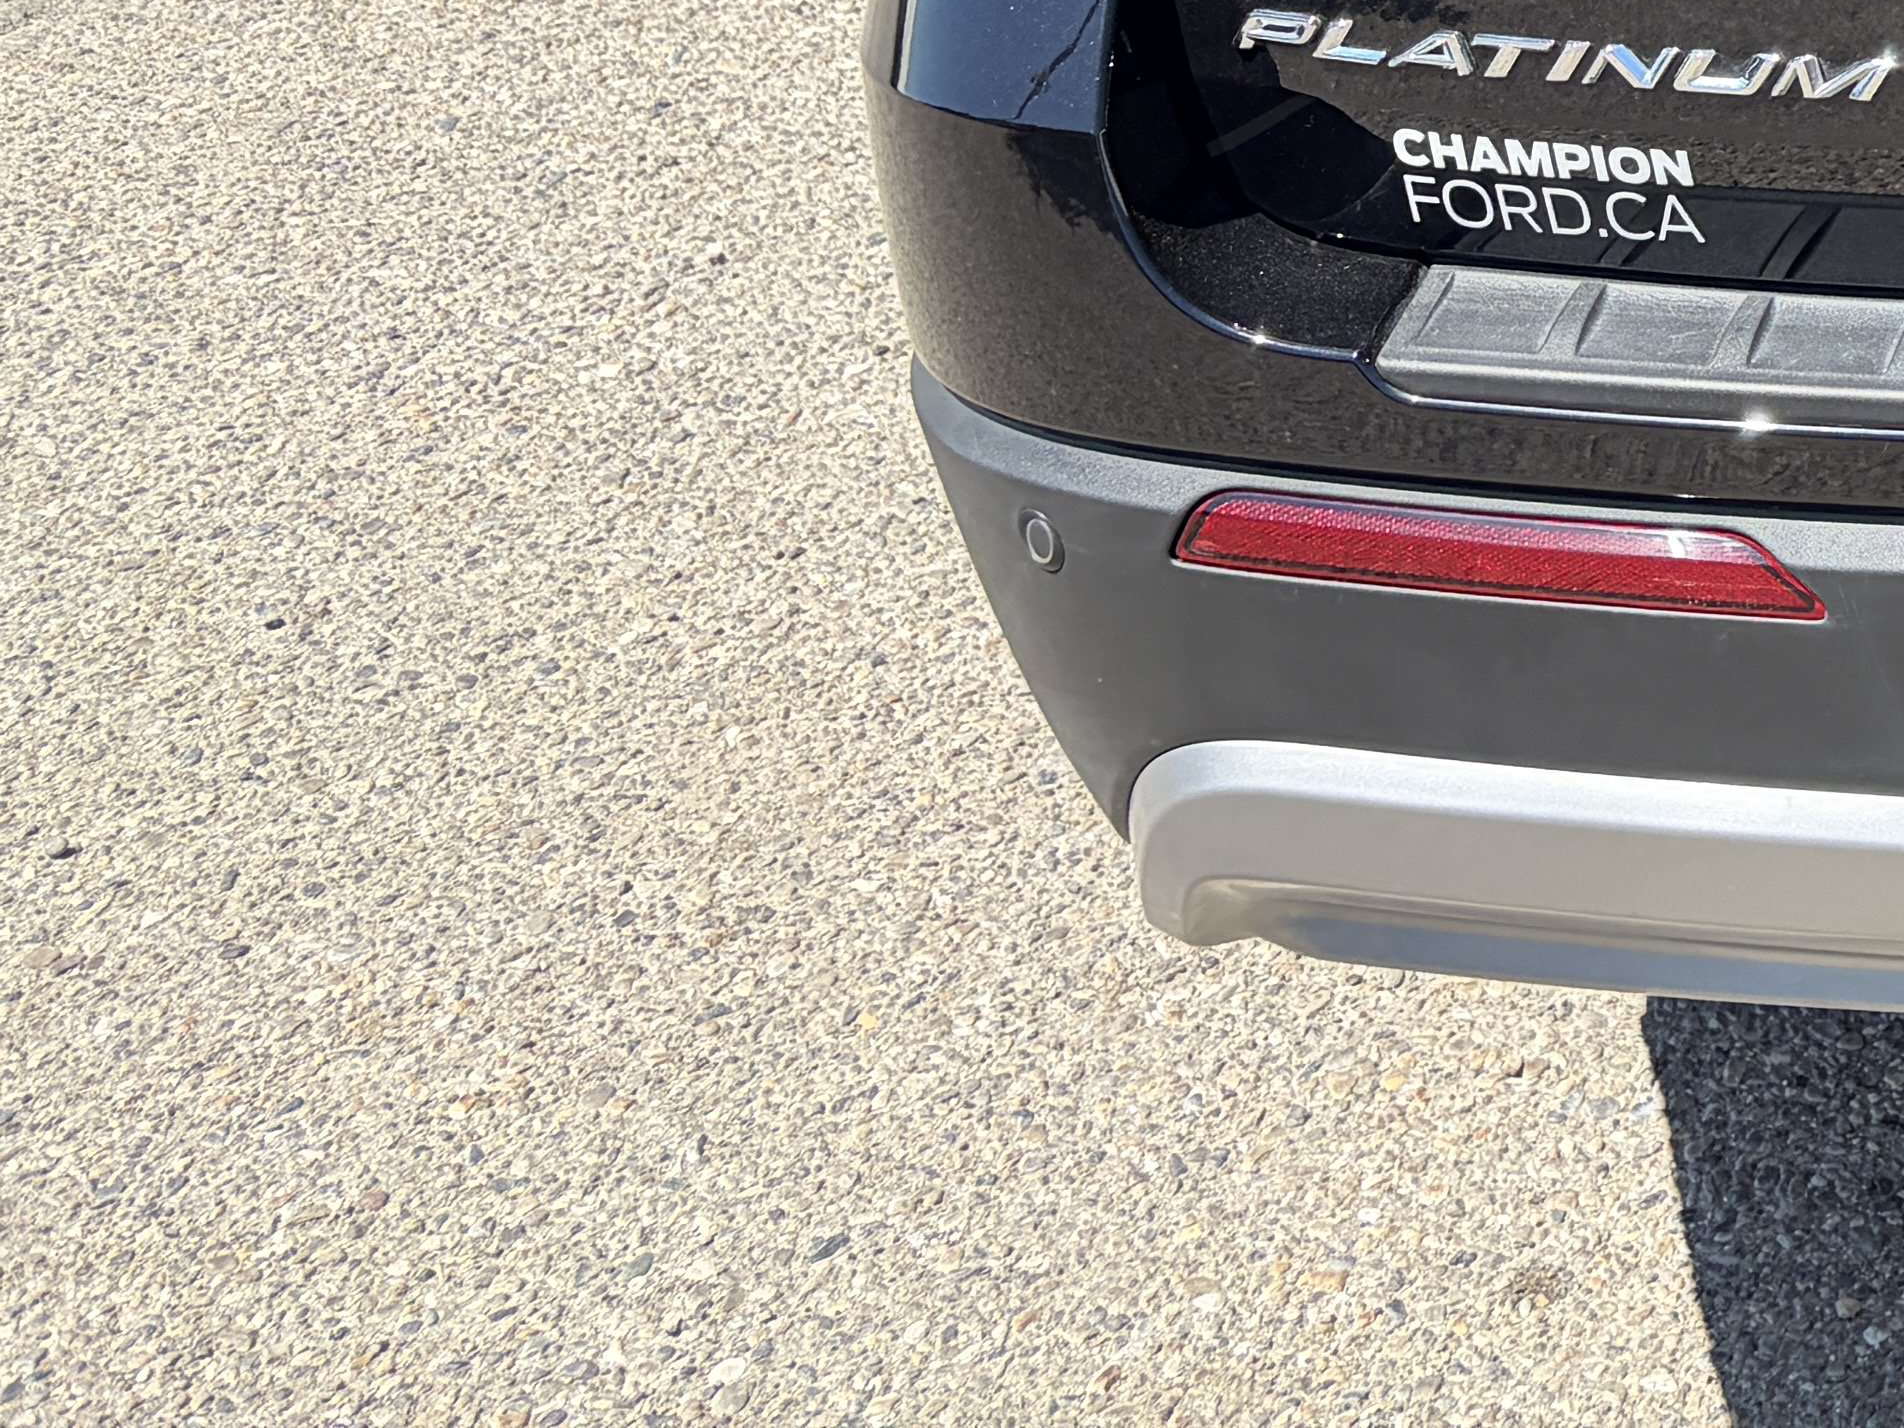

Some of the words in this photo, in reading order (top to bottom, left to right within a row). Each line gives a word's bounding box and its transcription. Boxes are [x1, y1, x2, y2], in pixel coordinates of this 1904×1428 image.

[1238, 8, 1895, 101] PLATINUM
[1393, 128, 1694, 187] CHAMPION
[1402, 174, 1705, 243] FORD.CA
